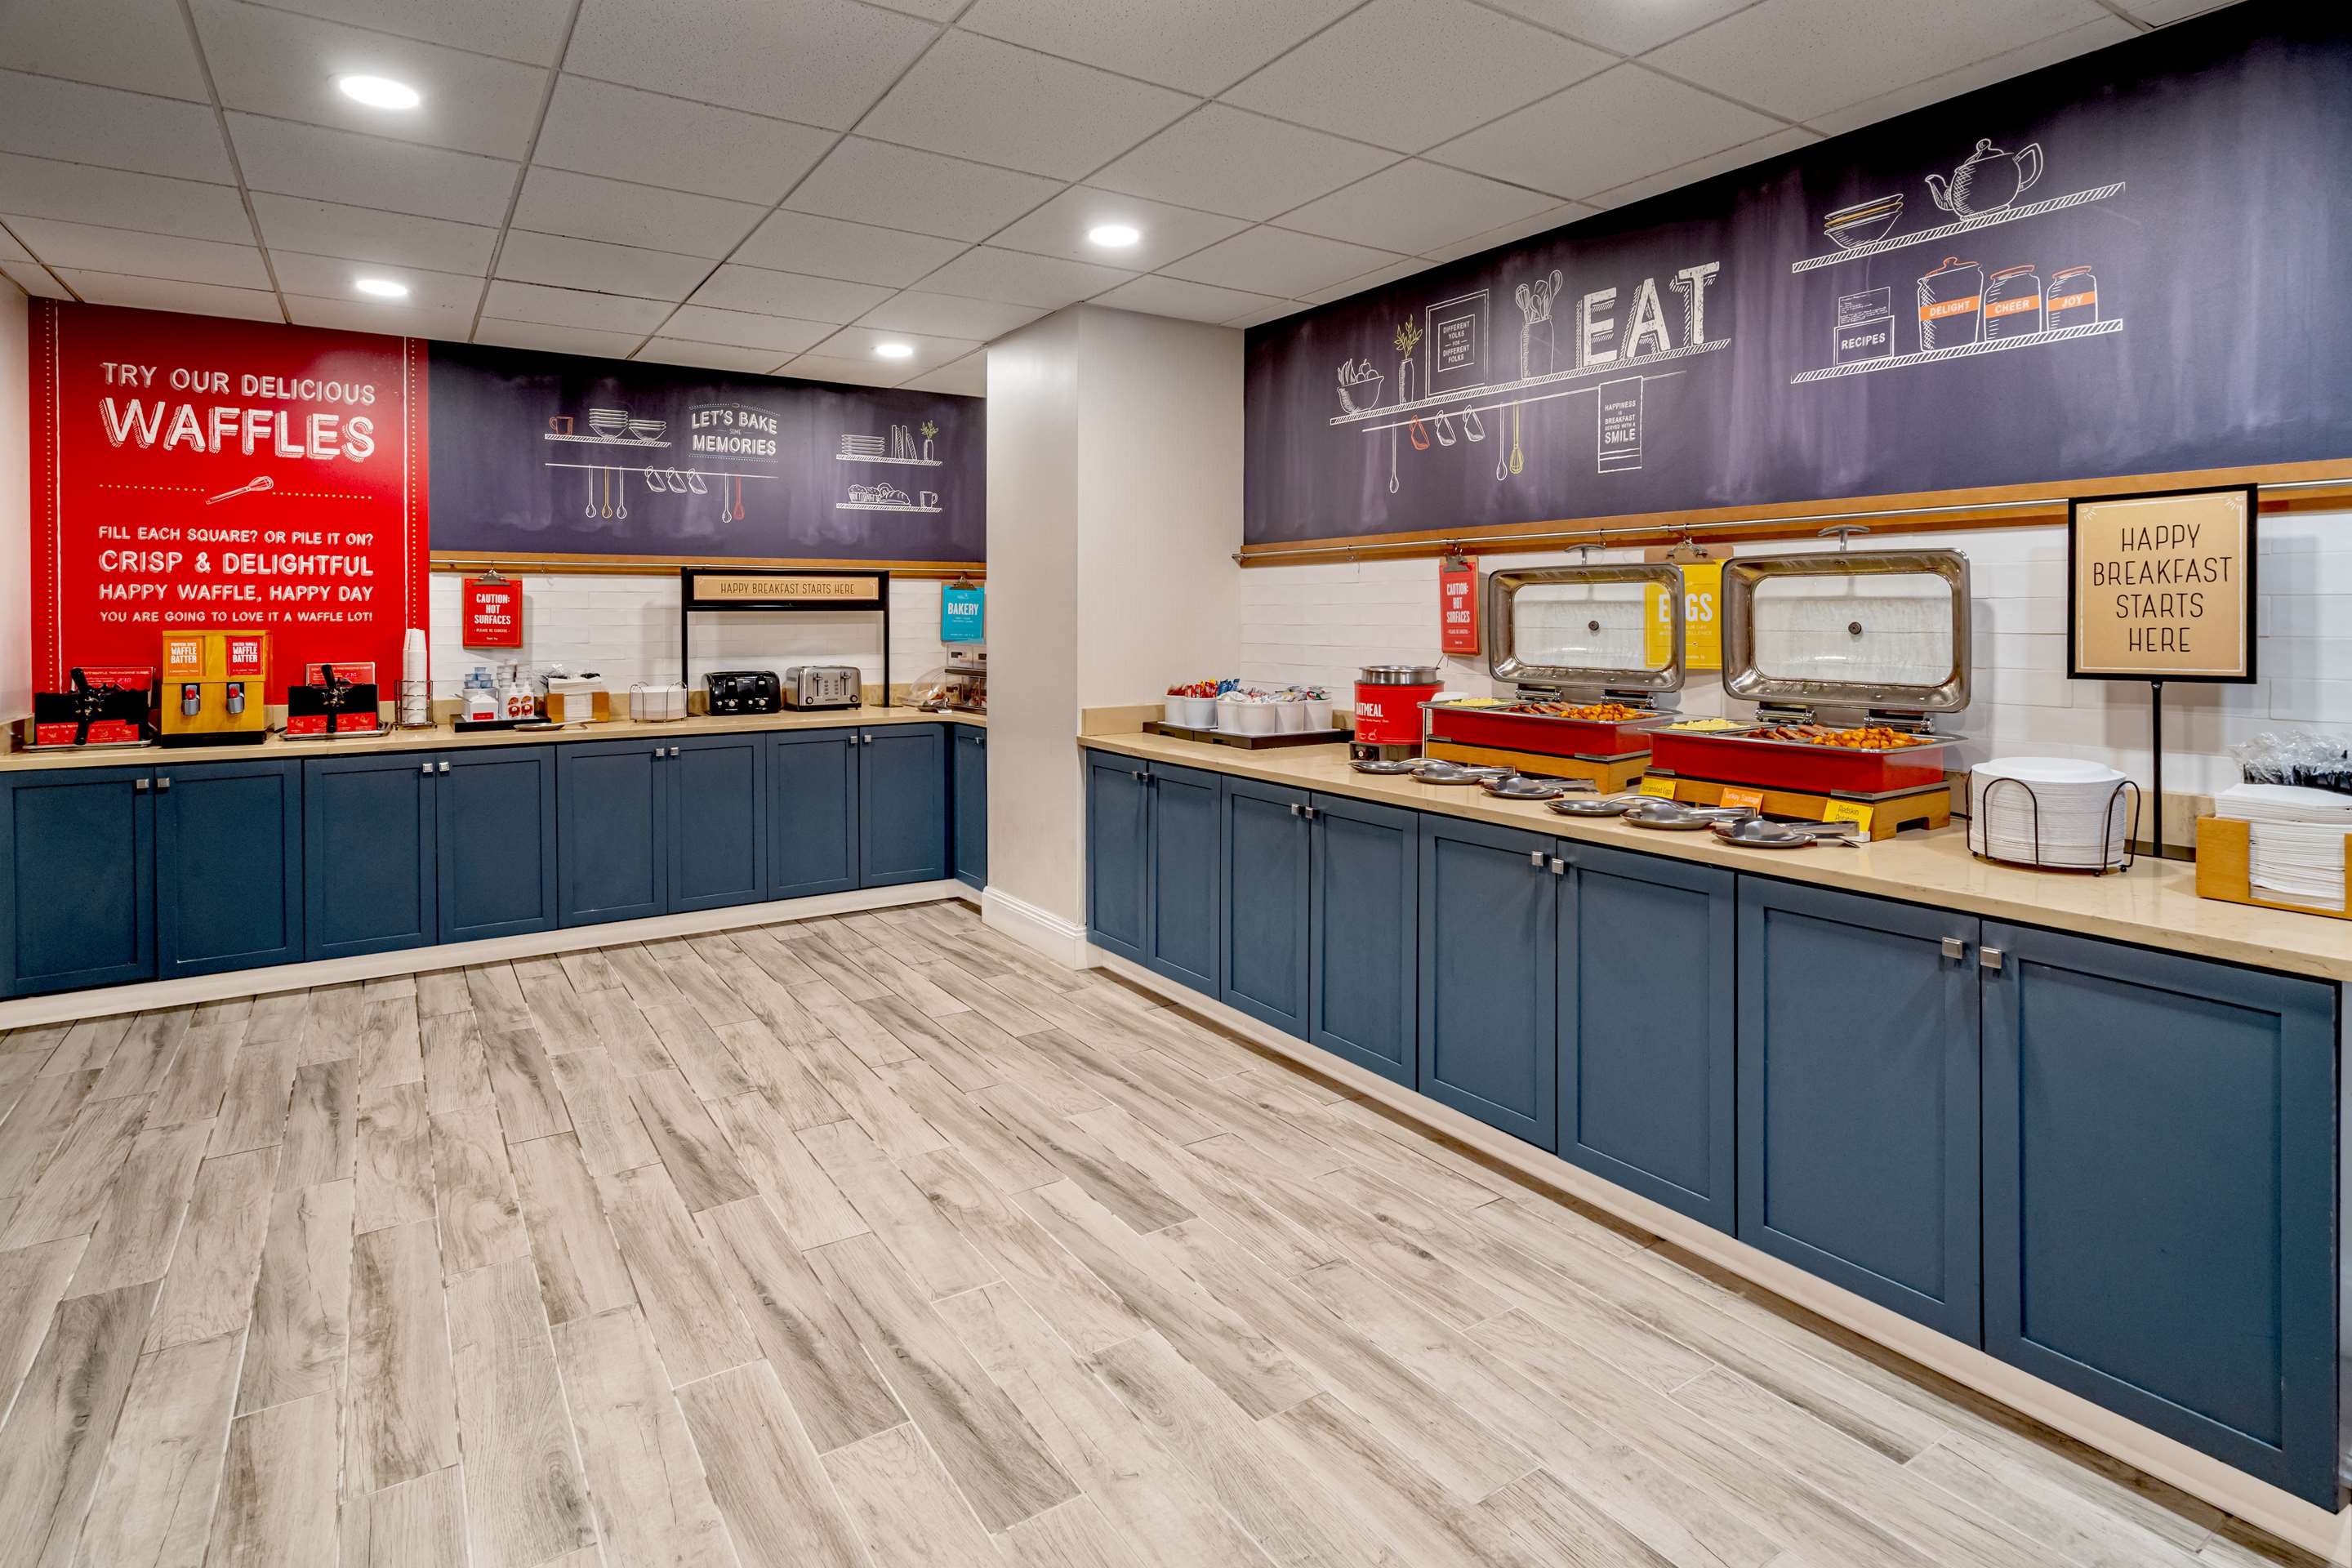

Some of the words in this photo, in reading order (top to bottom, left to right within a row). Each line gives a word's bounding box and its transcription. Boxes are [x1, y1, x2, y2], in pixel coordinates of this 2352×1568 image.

[1994, 299, 2029, 314] CHEER
[2061, 295, 2083, 308] JOY
[1575, 261, 1720, 368] EAT
[1929, 301, 1971, 316] DELIGHT
[1443, 321, 1470, 333] DIFFERENT
[1449, 330, 1464, 340] YOLKS
[1841, 332, 1886, 350] RECIPES
[1443, 345, 1470, 357] DIFFERENT
[1448, 354, 1464, 363] FOLKS
[100, 362, 158, 389] TRY
[169, 368, 230, 394] OUR
[242, 374, 376, 405] DELICIOUS
[1605, 400, 1637, 412] HAPPINESS
[692, 409, 733, 430] LET'S
[738, 412, 777, 435] BAKE
[1605, 414, 1636, 425] BREAKFAST
[98, 397, 375, 463] WAFFLES
[1605, 428, 1636, 444] SMILE
[692, 434, 777, 457] MEMORIES
[98, 526, 131, 540] FILL
[137, 527, 180, 541] EACH
[187, 528, 258, 543] SQUARE?
[264, 530, 286, 544] OR
[292, 531, 323, 545] PILE
[327, 532, 341, 545] IT
[345, 532, 374, 546] ON?
[2122, 523, 2201, 552] HAPPY
[98, 550, 183, 572] CRISP
[194, 551, 212, 573] &
[222, 552, 374, 577] DELIGHTFUL
[2093, 557, 2233, 586] BREAKFAST
[99, 583, 168, 601] HAPPY
[176, 583, 262, 603] WAFFLE,
[270, 585, 331, 602] HAPPY
[338, 586, 374, 602] DAY
[720, 582, 749, 595] HAPPY
[752, 582, 799, 595] BREAKFAST
[802, 582, 831, 595] STARTS
[835, 583, 855, 595] HERE
[1446, 582, 1469, 595] CAUTION:
[476, 593, 510, 604] CAUTION:
[1453, 597, 1463, 609] HOT
[485, 604, 501, 614] HOT
[947, 602, 979, 616] BAKERY
[1659, 593, 1713, 622] EGS
[2116, 593, 2204, 618] STARTS
[100, 611, 127, 622] YOU
[132, 611, 159, 622] ARE
[164, 611, 206, 622] GOING
[211, 612, 228, 621] TO
[232, 611, 263, 622] LOVE
[268, 612, 279, 621] IT
[283, 612, 292, 621] A
[296, 612, 343, 621] WAFFLE
[347, 612, 373, 621] LOT!
[474, 614, 511, 625] SURFACES
[1446, 610, 1470, 623] SURFACES
[2129, 627, 2192, 653] HERE
[170, 646, 197, 655] WAFFLE
[232, 646, 258, 655] WAFFLE
[170, 655, 197, 664] BATTER
[232, 655, 258, 663] BATTER
